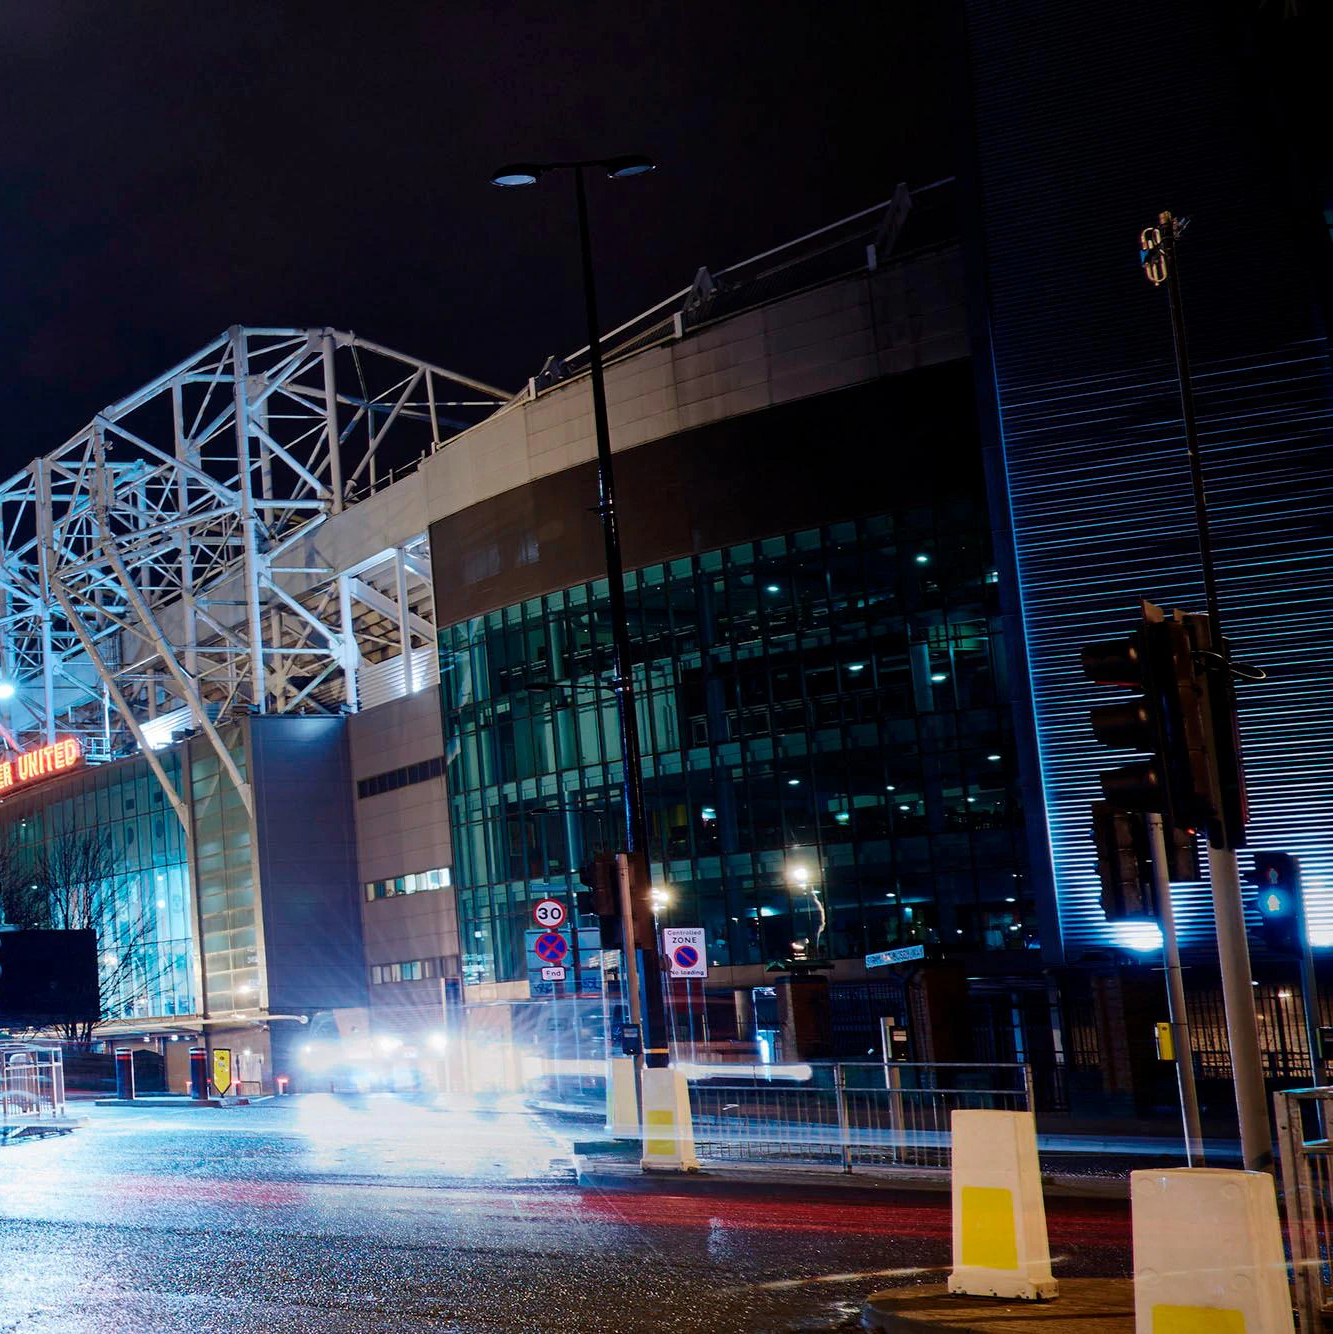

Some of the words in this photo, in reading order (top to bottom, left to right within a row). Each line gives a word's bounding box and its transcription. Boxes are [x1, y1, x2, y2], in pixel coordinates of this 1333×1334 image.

[17, 739, 79, 781] UNITED
[538, 907, 562, 920] 30
[672, 936, 697, 944] ZONE
